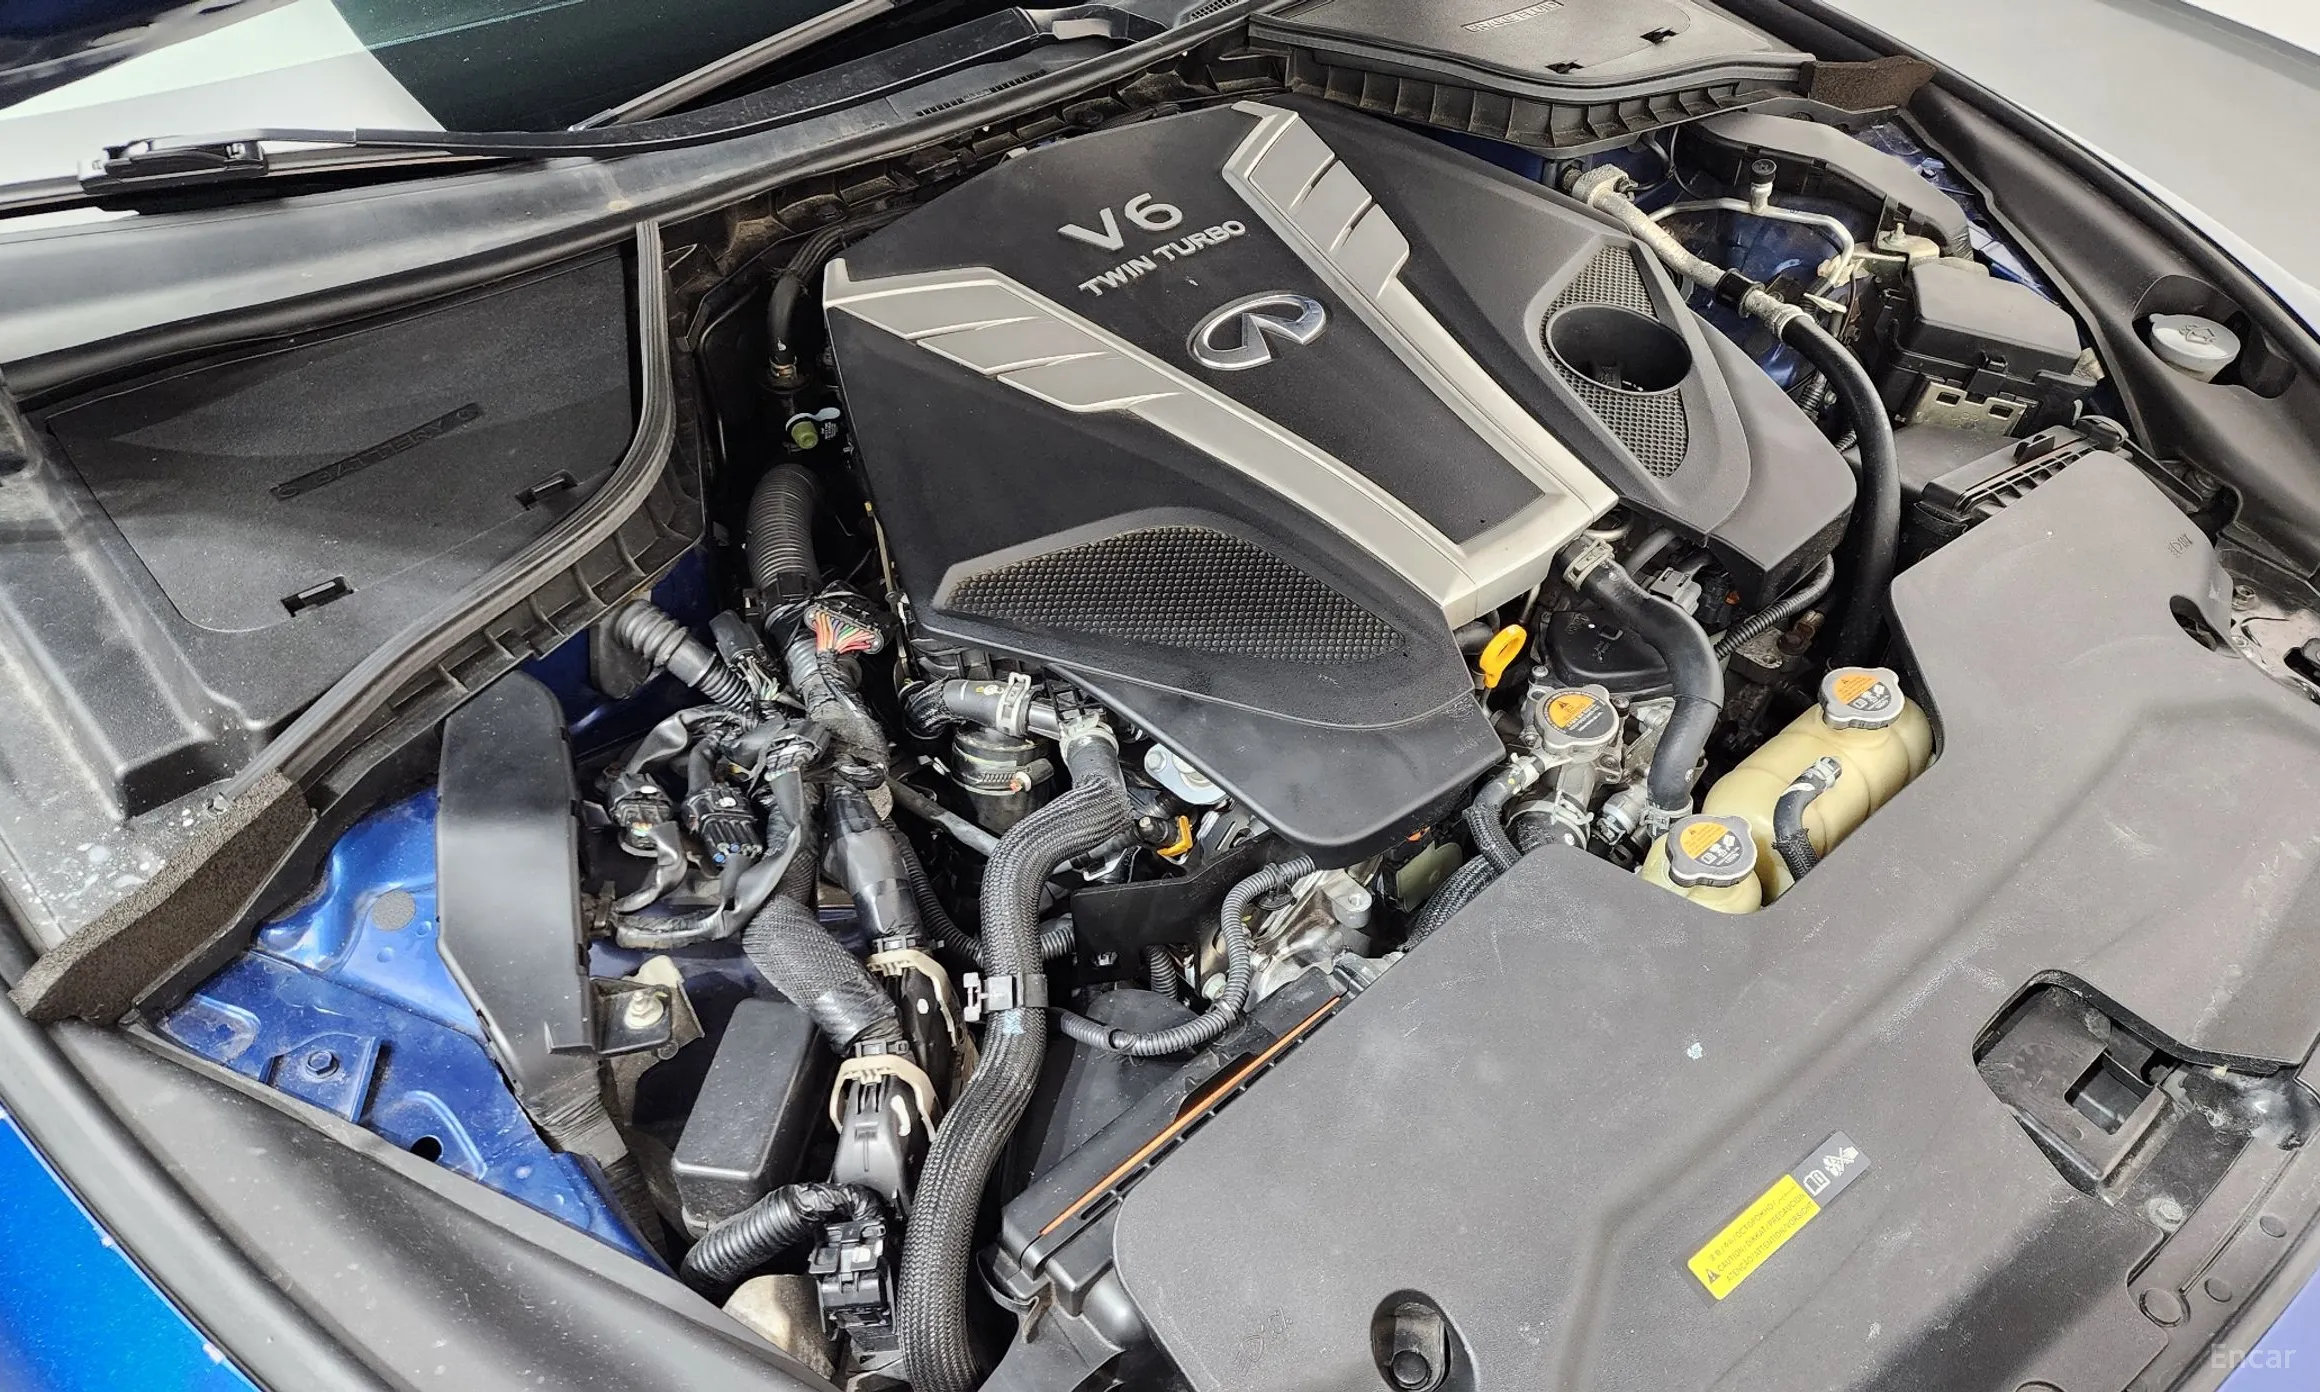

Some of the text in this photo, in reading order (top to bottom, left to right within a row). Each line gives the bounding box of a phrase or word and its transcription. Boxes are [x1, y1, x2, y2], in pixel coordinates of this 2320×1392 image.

[1057, 192, 1183, 251] V6
[1078, 220, 1246, 297] TWIN TURBO
[316, 418, 444, 484] BATTERY
